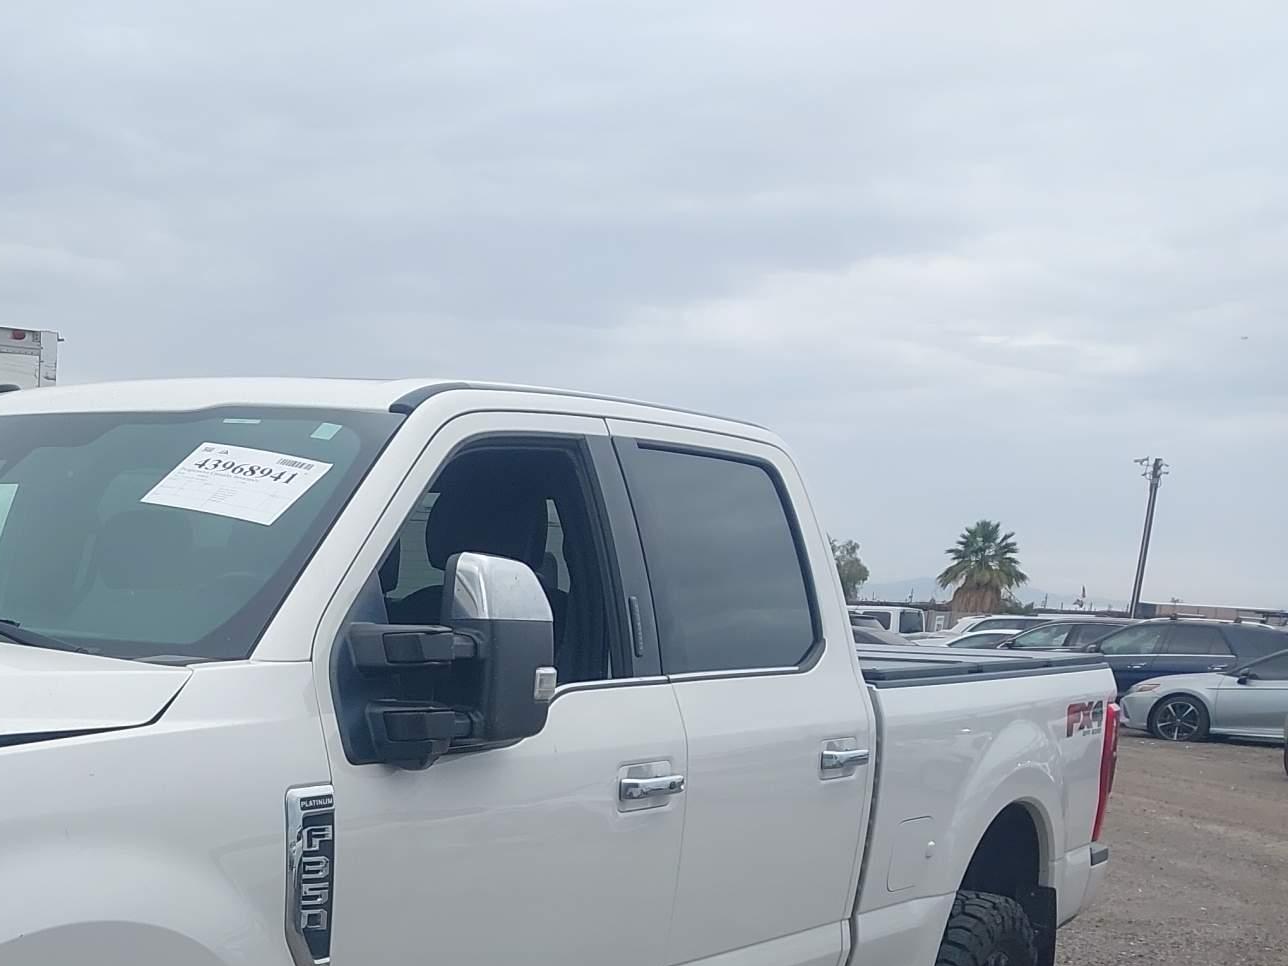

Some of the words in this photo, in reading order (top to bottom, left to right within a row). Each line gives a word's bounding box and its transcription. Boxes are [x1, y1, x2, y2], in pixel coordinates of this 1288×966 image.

[194, 458, 299, 484] 43968941
[1066, 700, 1103, 738] FX4
[301, 796, 333, 808] PLATINUM
